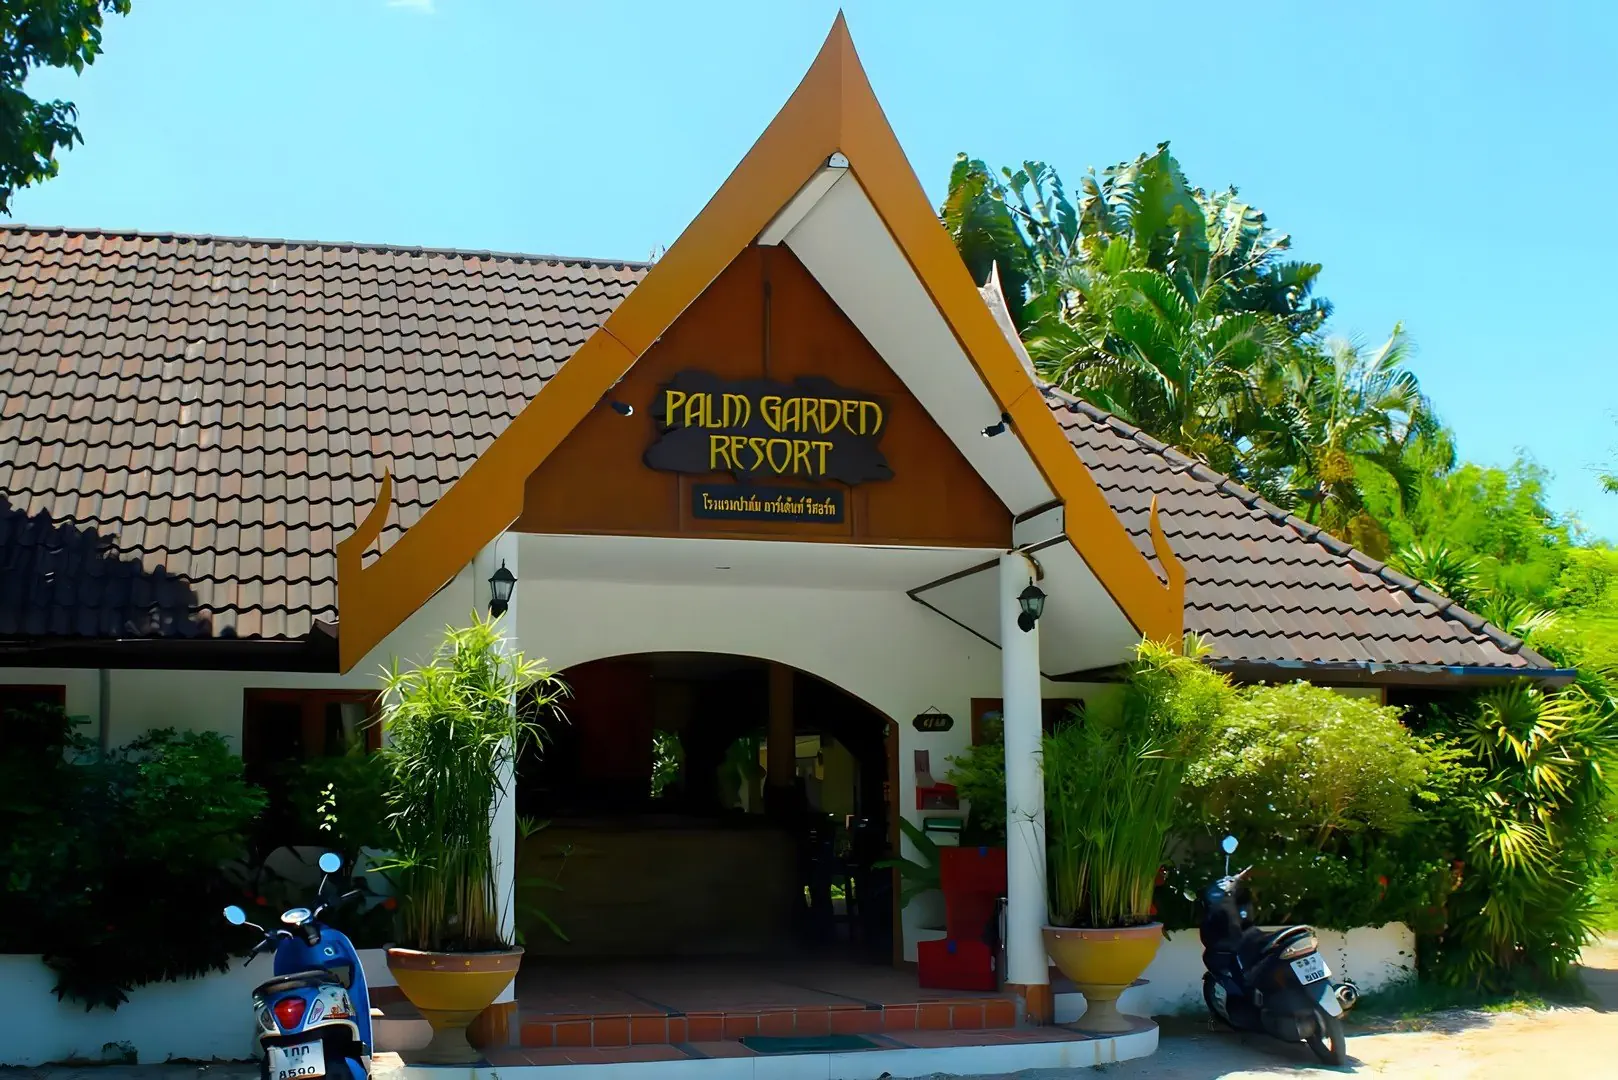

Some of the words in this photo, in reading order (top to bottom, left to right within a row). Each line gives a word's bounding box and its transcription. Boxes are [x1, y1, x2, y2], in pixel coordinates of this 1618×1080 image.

[665, 390, 751, 429] PALM
[759, 395, 883, 435] GARDEN
[709, 434, 833, 475] RESORT
